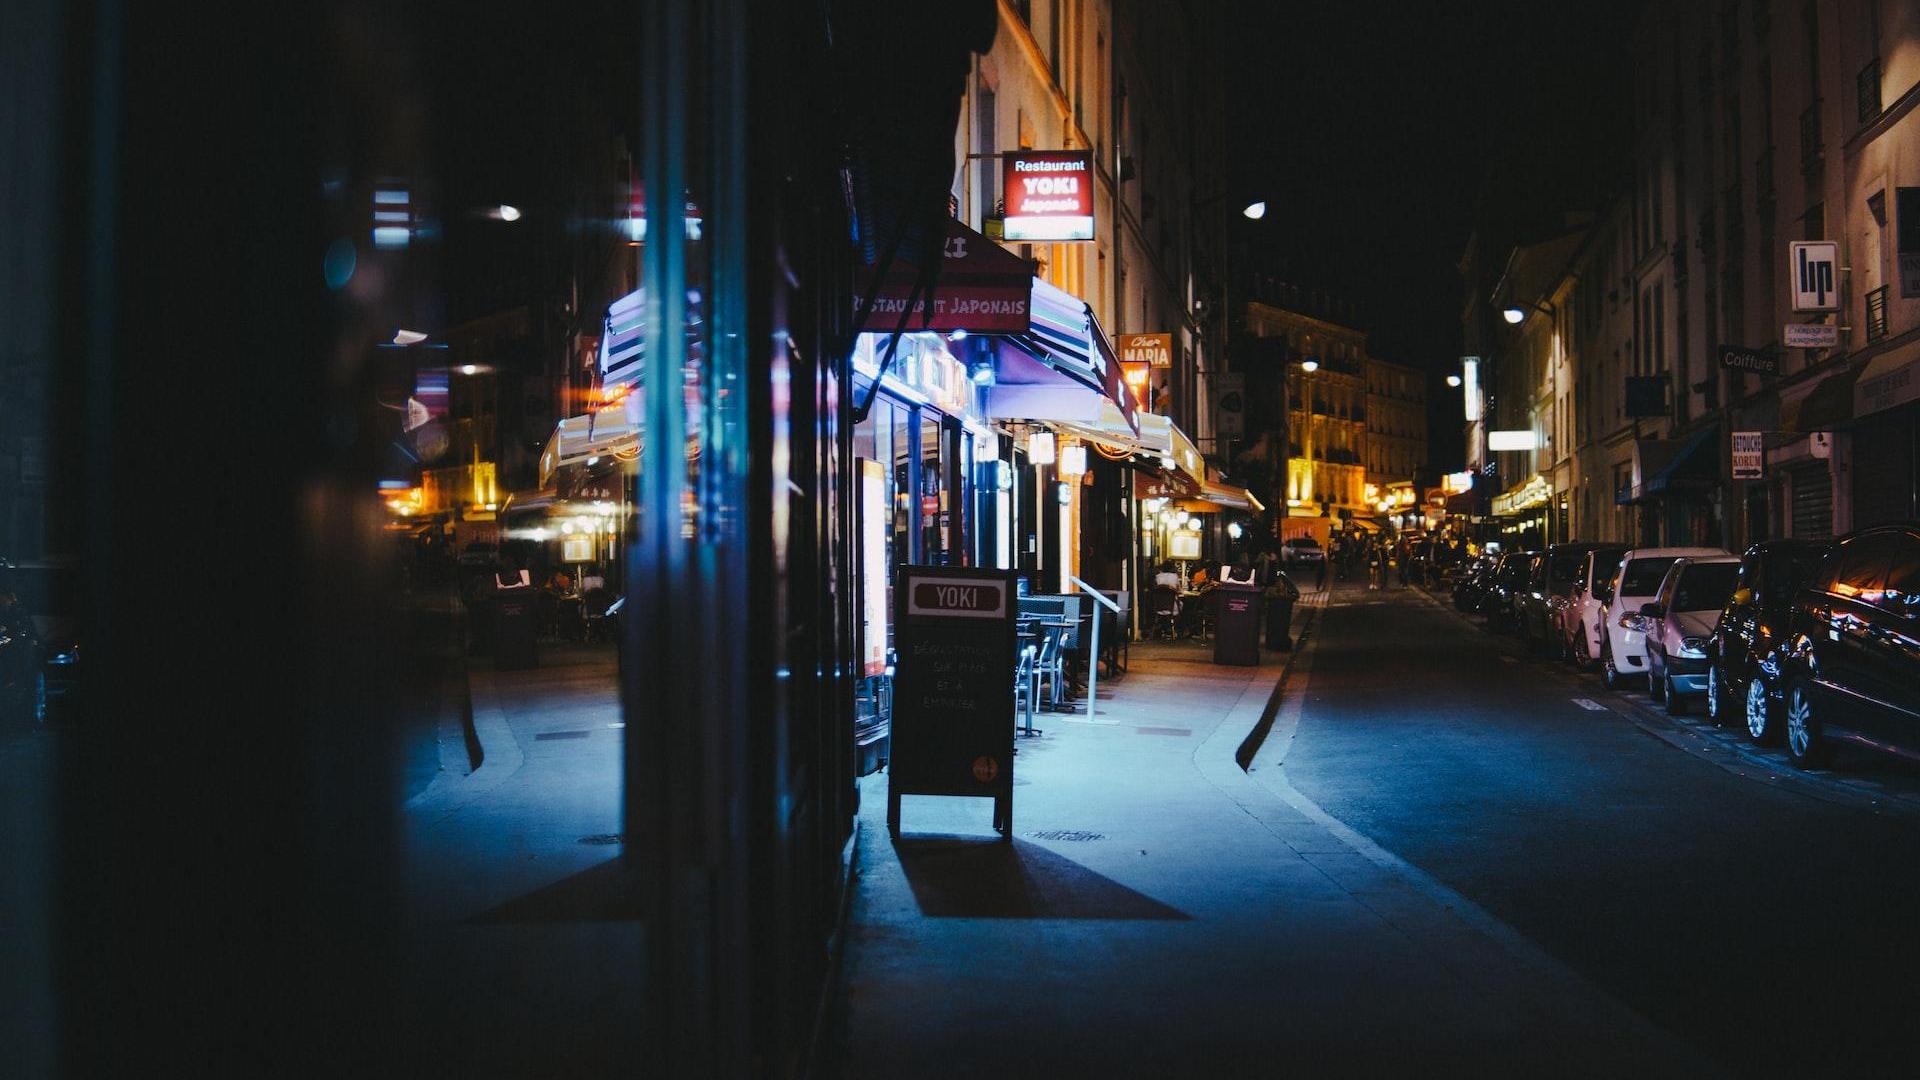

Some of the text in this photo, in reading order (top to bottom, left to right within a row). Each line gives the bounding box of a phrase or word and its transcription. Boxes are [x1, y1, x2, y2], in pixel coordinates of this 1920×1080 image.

[1015, 160, 1085, 171] Restaurant
[1023, 177, 1079, 195] YOKI
[950, 297, 1026, 315] JAPONAIS
[1124, 348, 1169, 365] MARIA
[1725, 352, 1774, 371] Coiffure
[936, 586, 977, 608] YOKI
